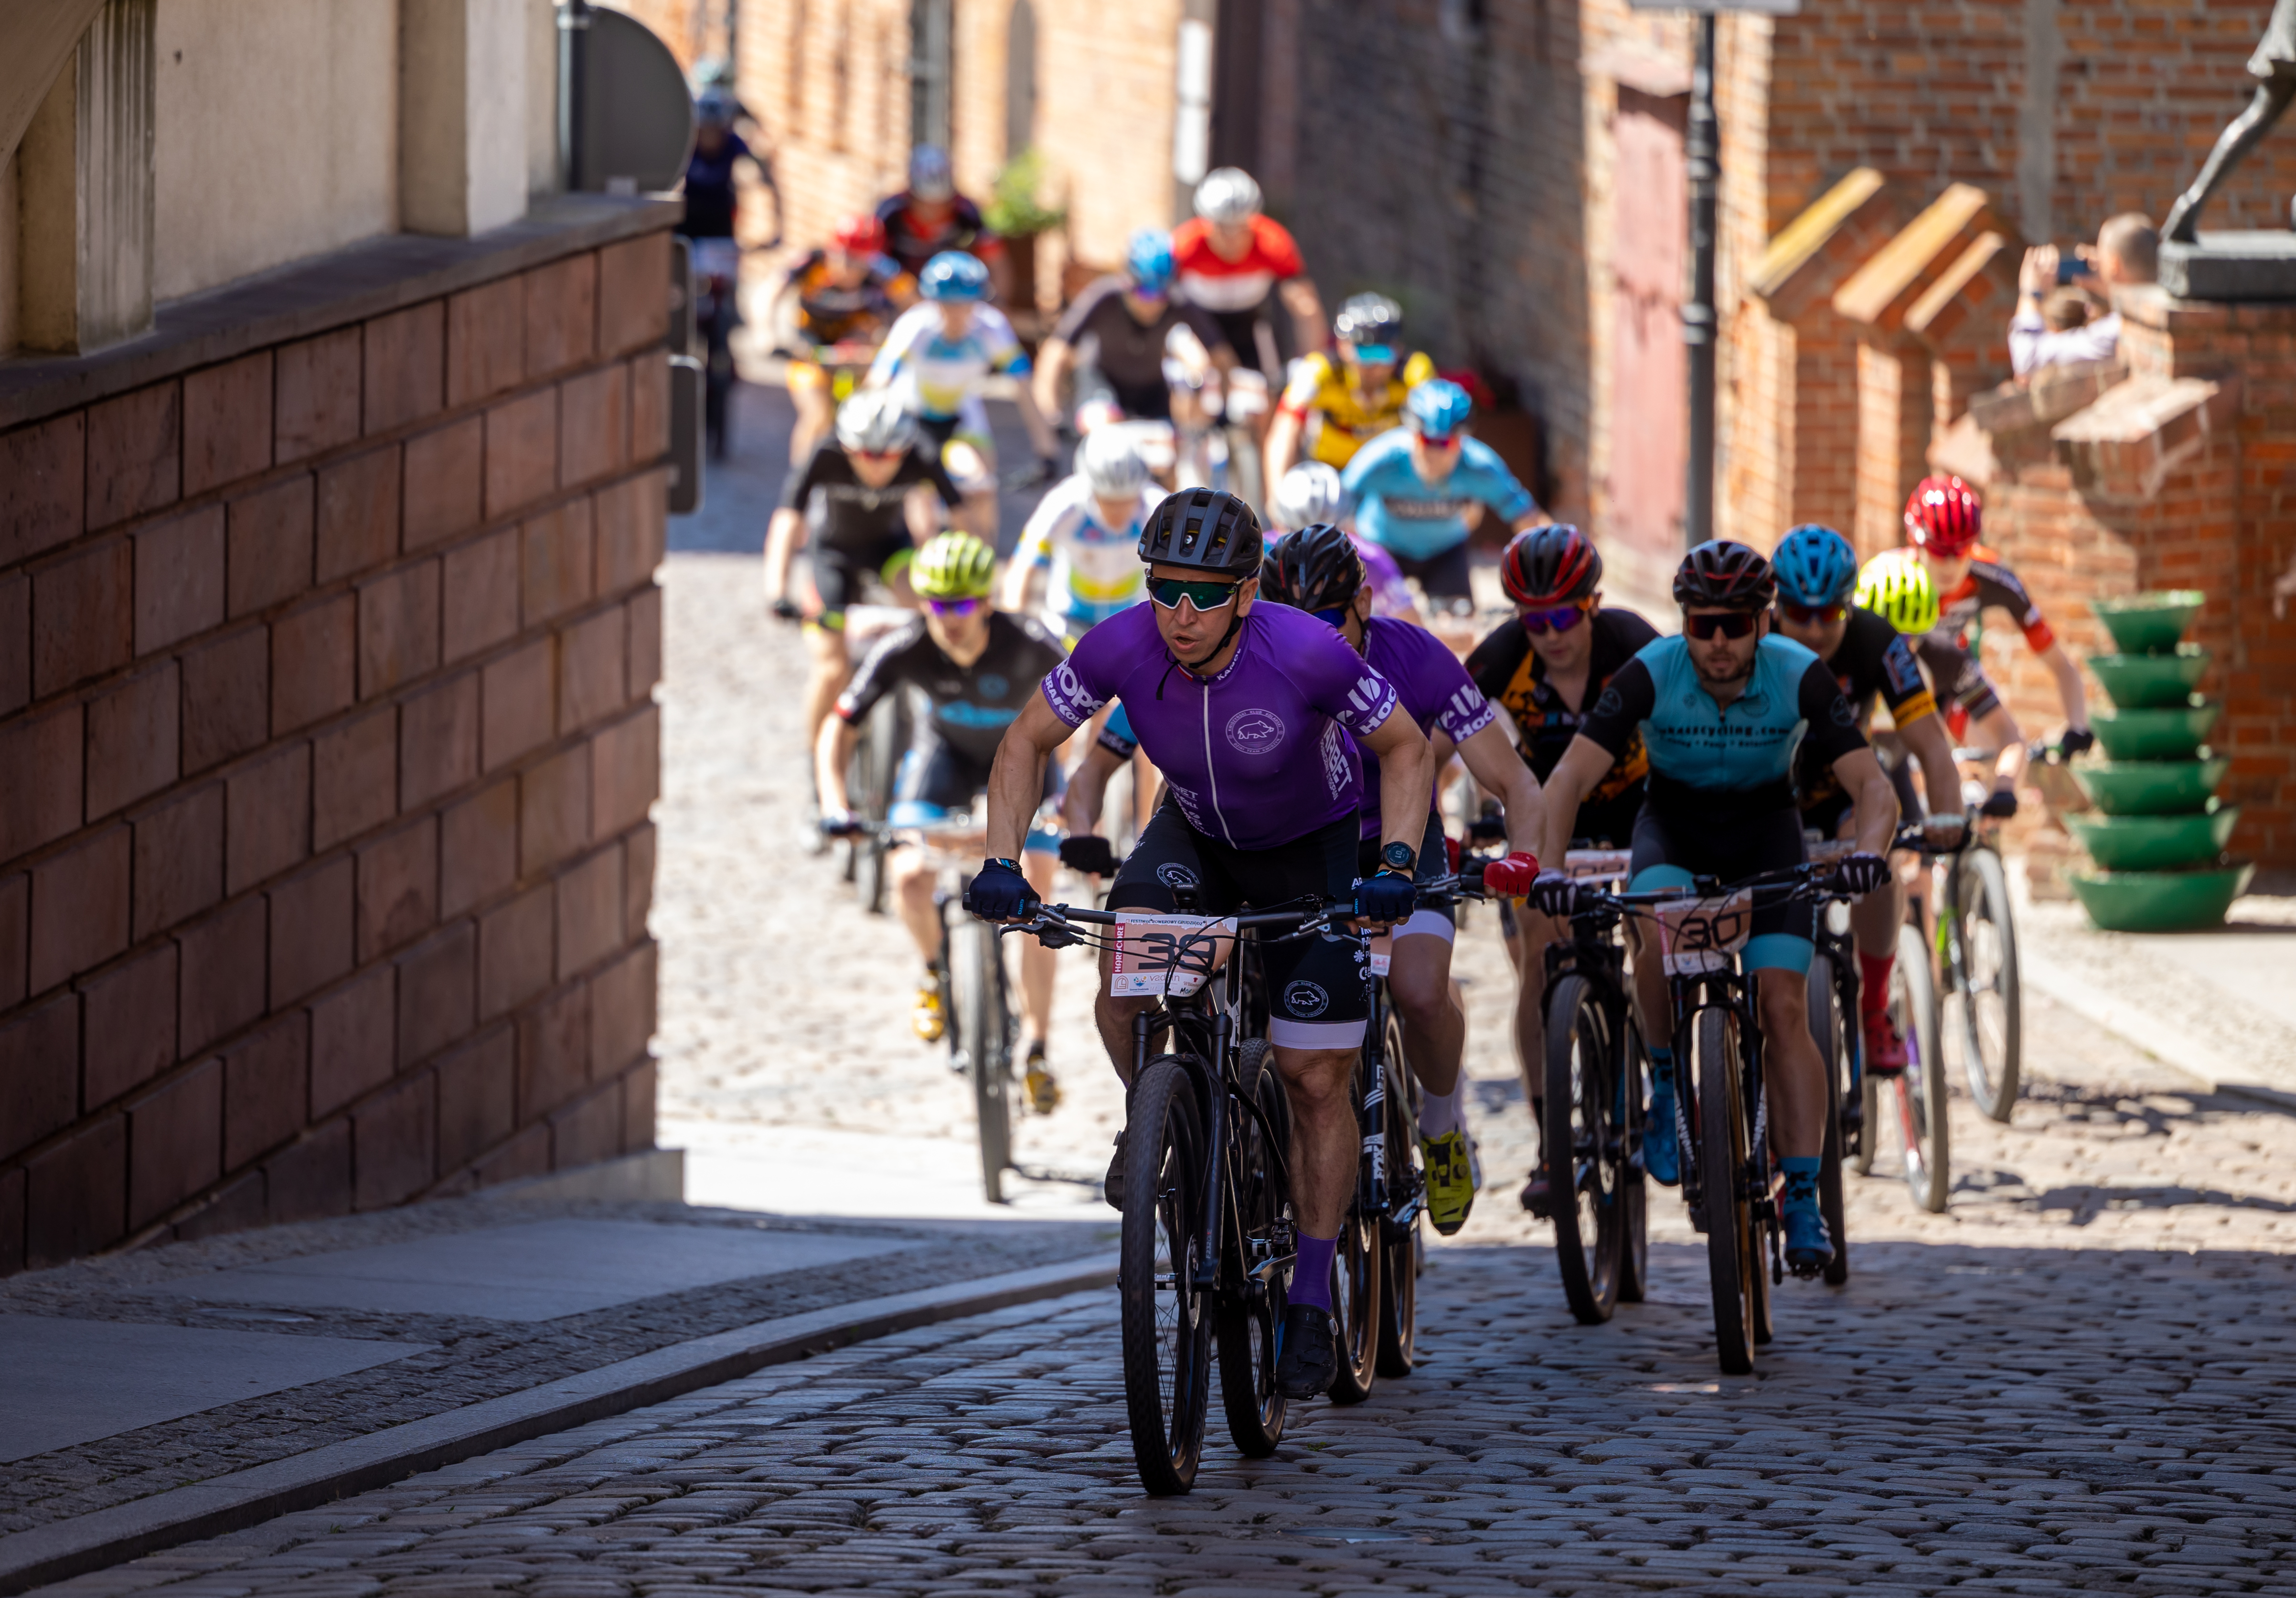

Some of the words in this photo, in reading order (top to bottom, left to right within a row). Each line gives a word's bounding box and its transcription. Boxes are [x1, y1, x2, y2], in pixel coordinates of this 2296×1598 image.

[1265, 713, 1281, 728] KOLARSKI
[1114, 924, 1124, 972] HARDCORE
[1682, 913, 1741, 949] 30
[1138, 933, 1217, 971] 39
